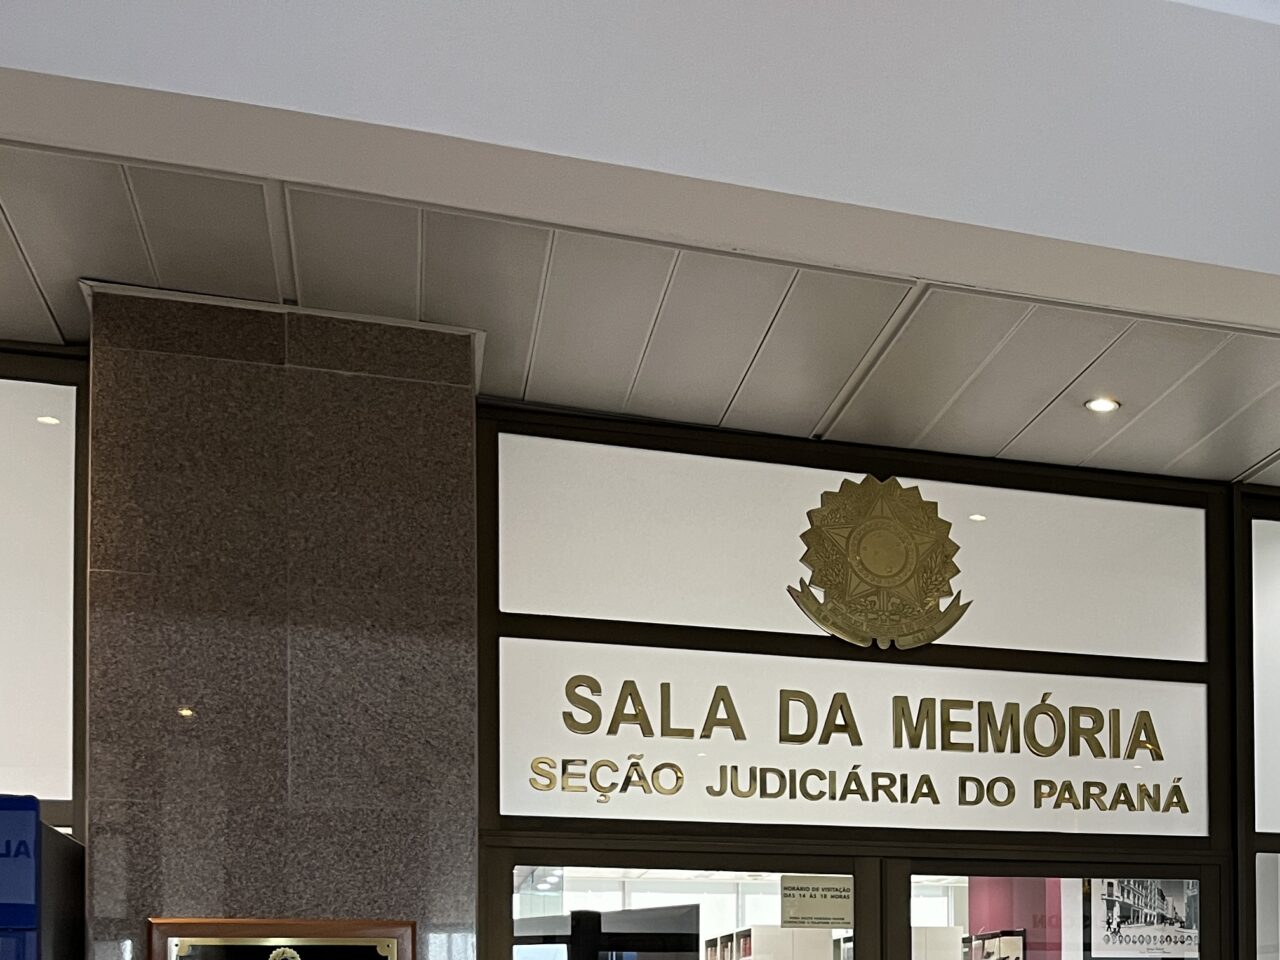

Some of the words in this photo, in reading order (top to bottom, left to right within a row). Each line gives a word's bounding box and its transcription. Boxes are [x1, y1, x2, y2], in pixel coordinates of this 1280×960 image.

[562, 674, 746, 741] SALA
[779, 688, 863, 747] DA
[892, 692, 1165, 762] MEMÓRIA
[528, 753, 685, 804] SEÇÃO
[705, 764, 941, 805] JUDICIÁRIA
[958, 775, 1016, 808] DO
[1033, 775, 1190, 815] PARANÁ
